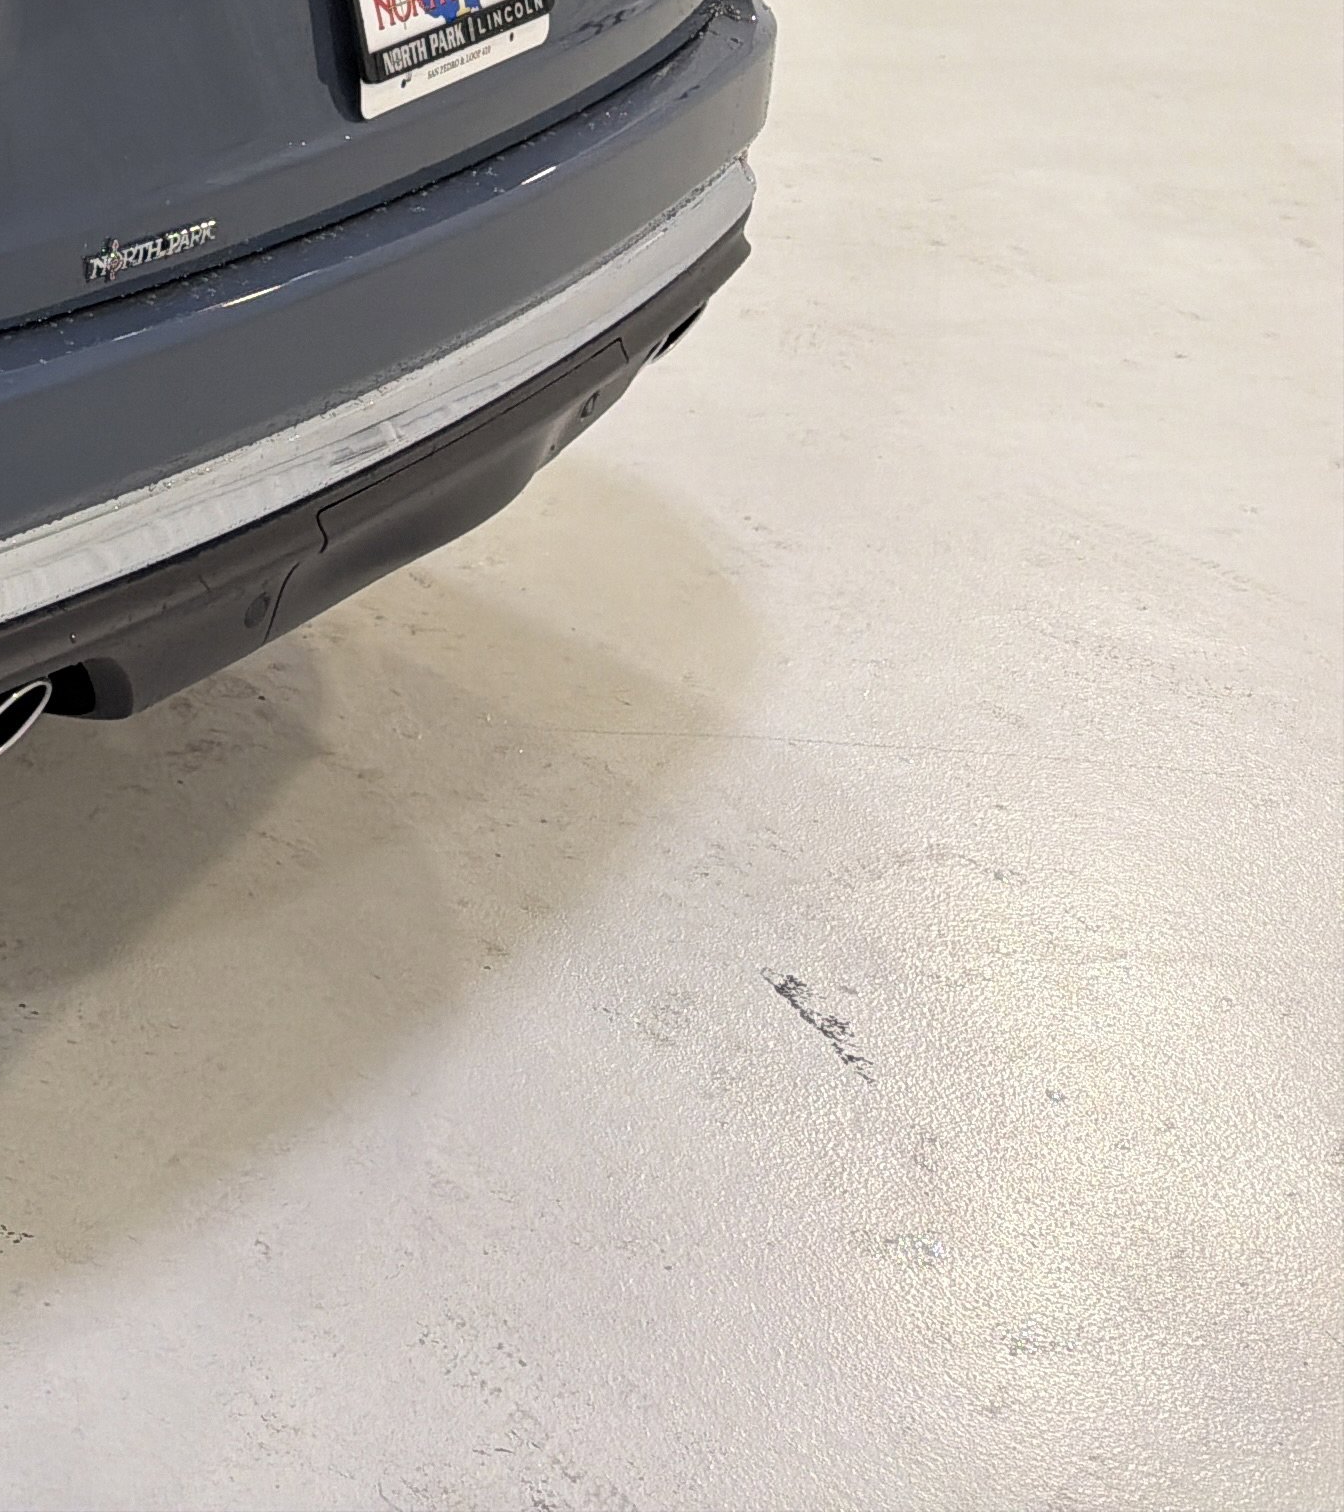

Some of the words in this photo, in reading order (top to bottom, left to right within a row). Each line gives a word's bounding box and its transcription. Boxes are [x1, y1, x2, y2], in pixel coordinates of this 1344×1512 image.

[382, 39, 429, 75] NORTH
[429, 22, 465, 56] PARK
[90, 237, 166, 280] NORTH
[166, 220, 216, 255] PARK
